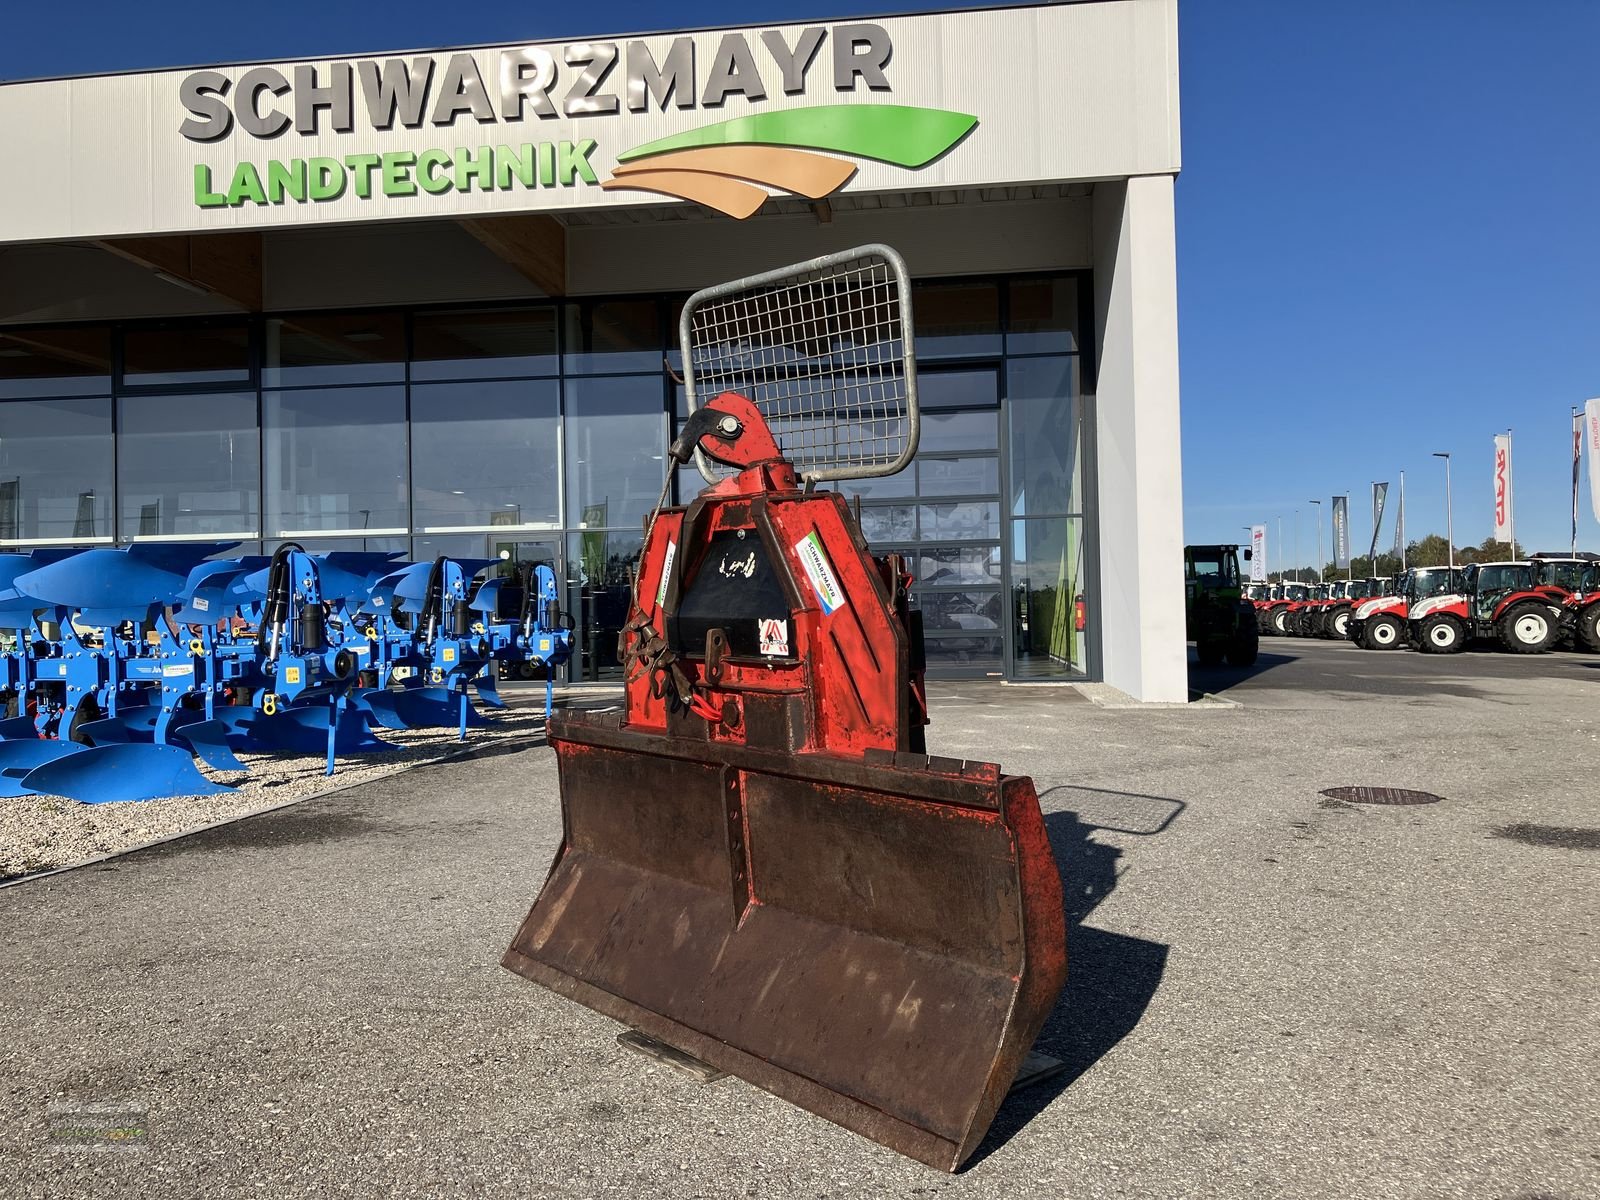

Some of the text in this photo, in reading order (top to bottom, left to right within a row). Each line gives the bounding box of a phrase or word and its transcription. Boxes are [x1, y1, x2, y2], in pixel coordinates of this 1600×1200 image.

[178, 23, 893, 144] SCHWARZMAYR
[194, 138, 599, 209] LANDTECHNIK
[807, 541, 836, 597] SCHWARZMAYR
